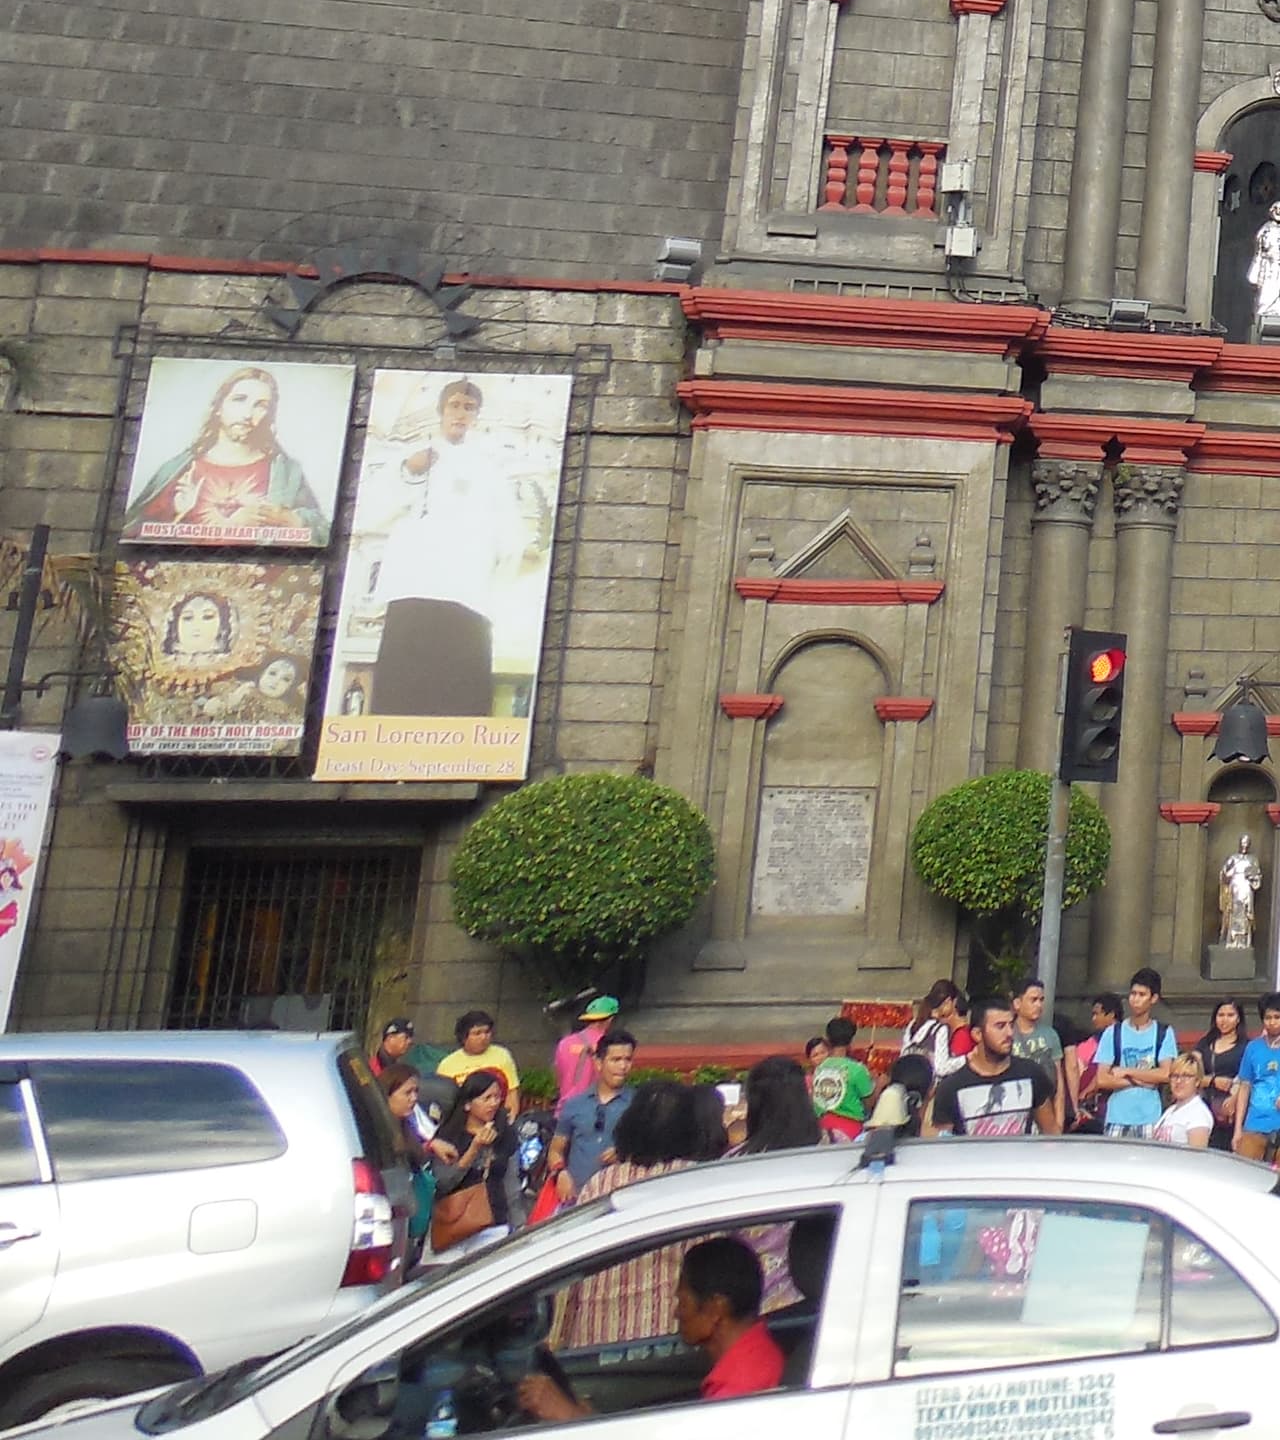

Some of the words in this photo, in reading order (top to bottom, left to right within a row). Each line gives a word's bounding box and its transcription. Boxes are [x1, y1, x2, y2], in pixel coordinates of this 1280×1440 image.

[143, 524, 175, 536] MOST
[177, 525, 222, 537] SACRED
[224, 526, 259, 538] HEART
[262, 527, 275, 539] OF
[127, 726, 147, 738] ADY
[151, 726, 165, 738] OF
[168, 726, 187, 738] THE
[190, 726, 223, 737] MOST
[225, 726, 253, 738] HOLY
[255, 726, 300, 738] ROSARY
[326, 723, 368, 744] San
[376, 723, 465, 745] Lorenzo
[473, 725, 521, 745] Ruiz
[325, 759, 363, 773] Feast
[409, 759, 491, 776] September
[497, 761, 516, 773] 28
[1079, 1373, 1115, 1391] 1342
